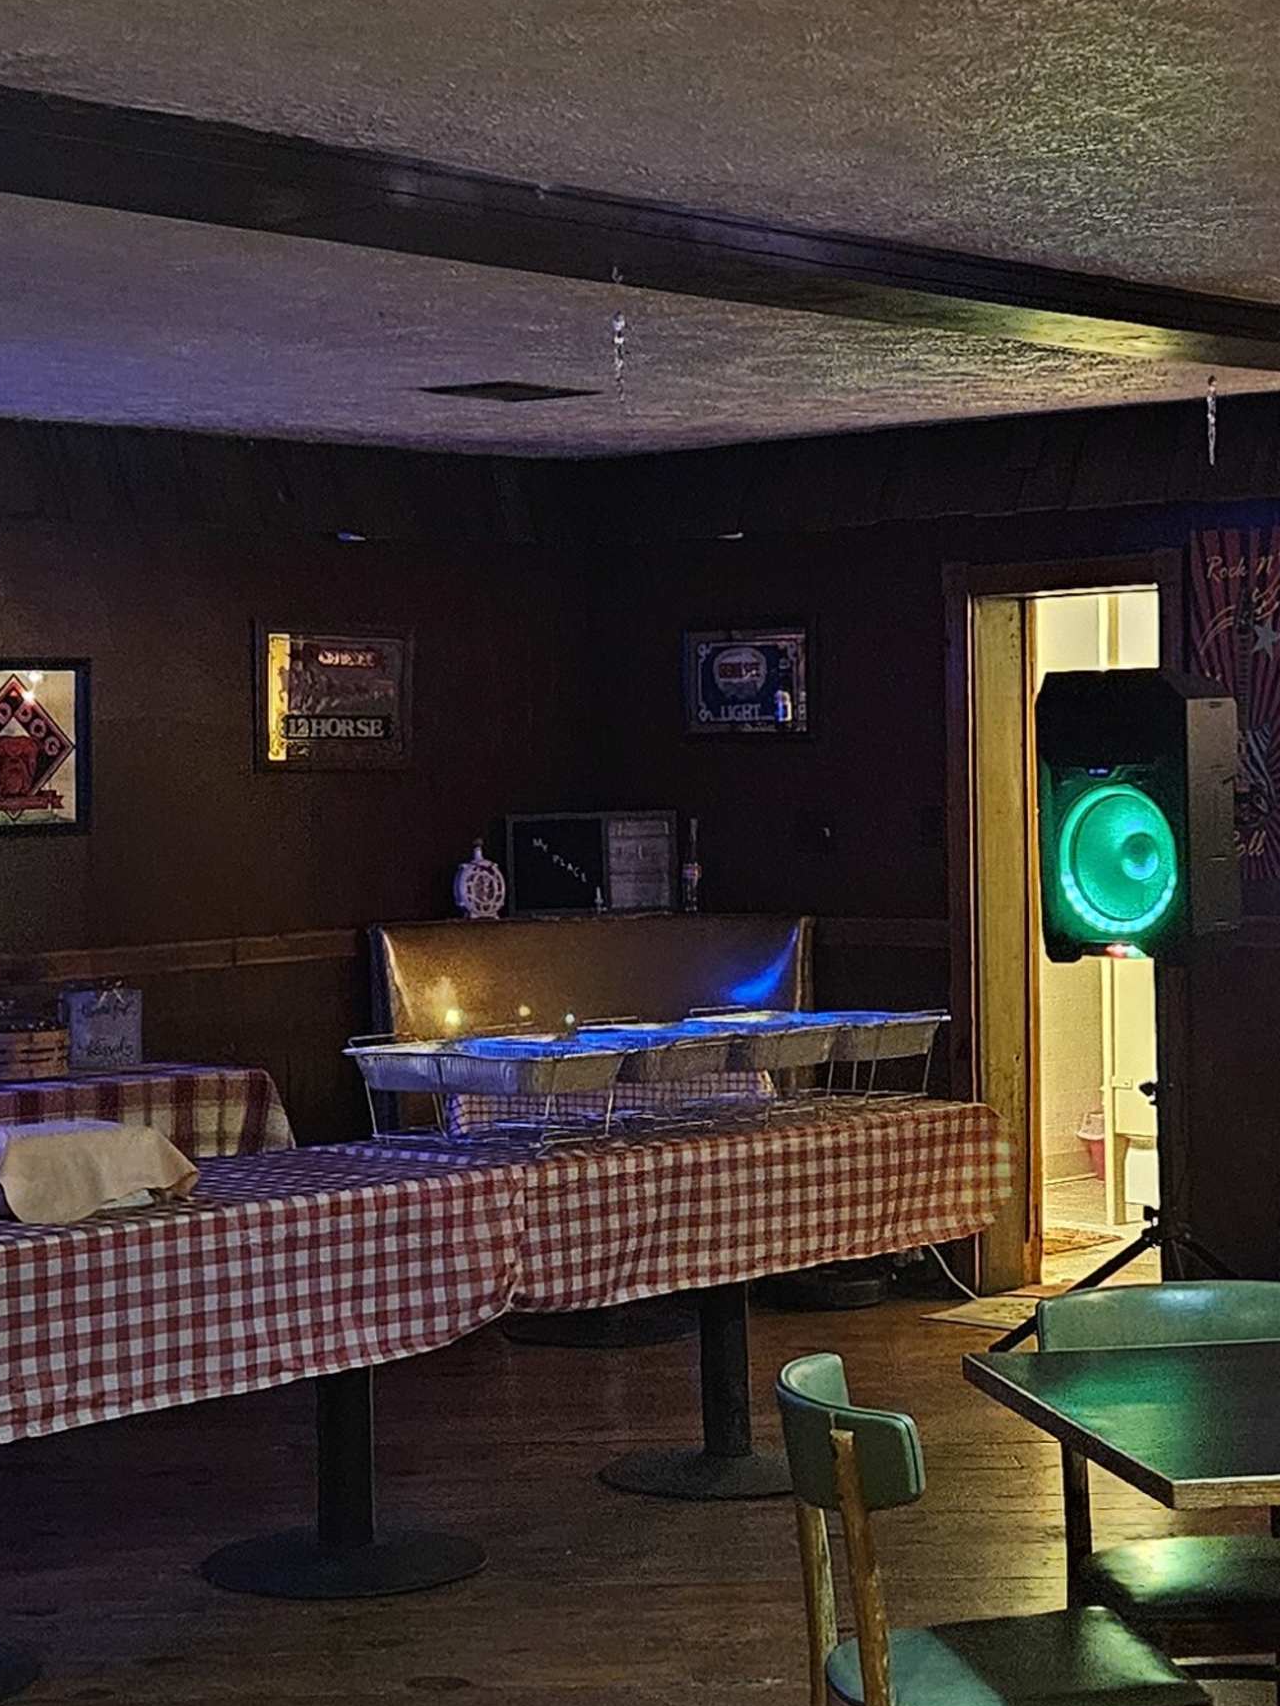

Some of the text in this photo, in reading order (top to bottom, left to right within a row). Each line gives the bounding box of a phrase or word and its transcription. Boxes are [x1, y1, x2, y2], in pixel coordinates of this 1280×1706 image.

[1205, 555, 1246, 582] Rock
[719, 703, 762, 722] LIGHT
[14, 701, 62, 757] DOG
[287, 717, 386, 738] 12 HORSE
